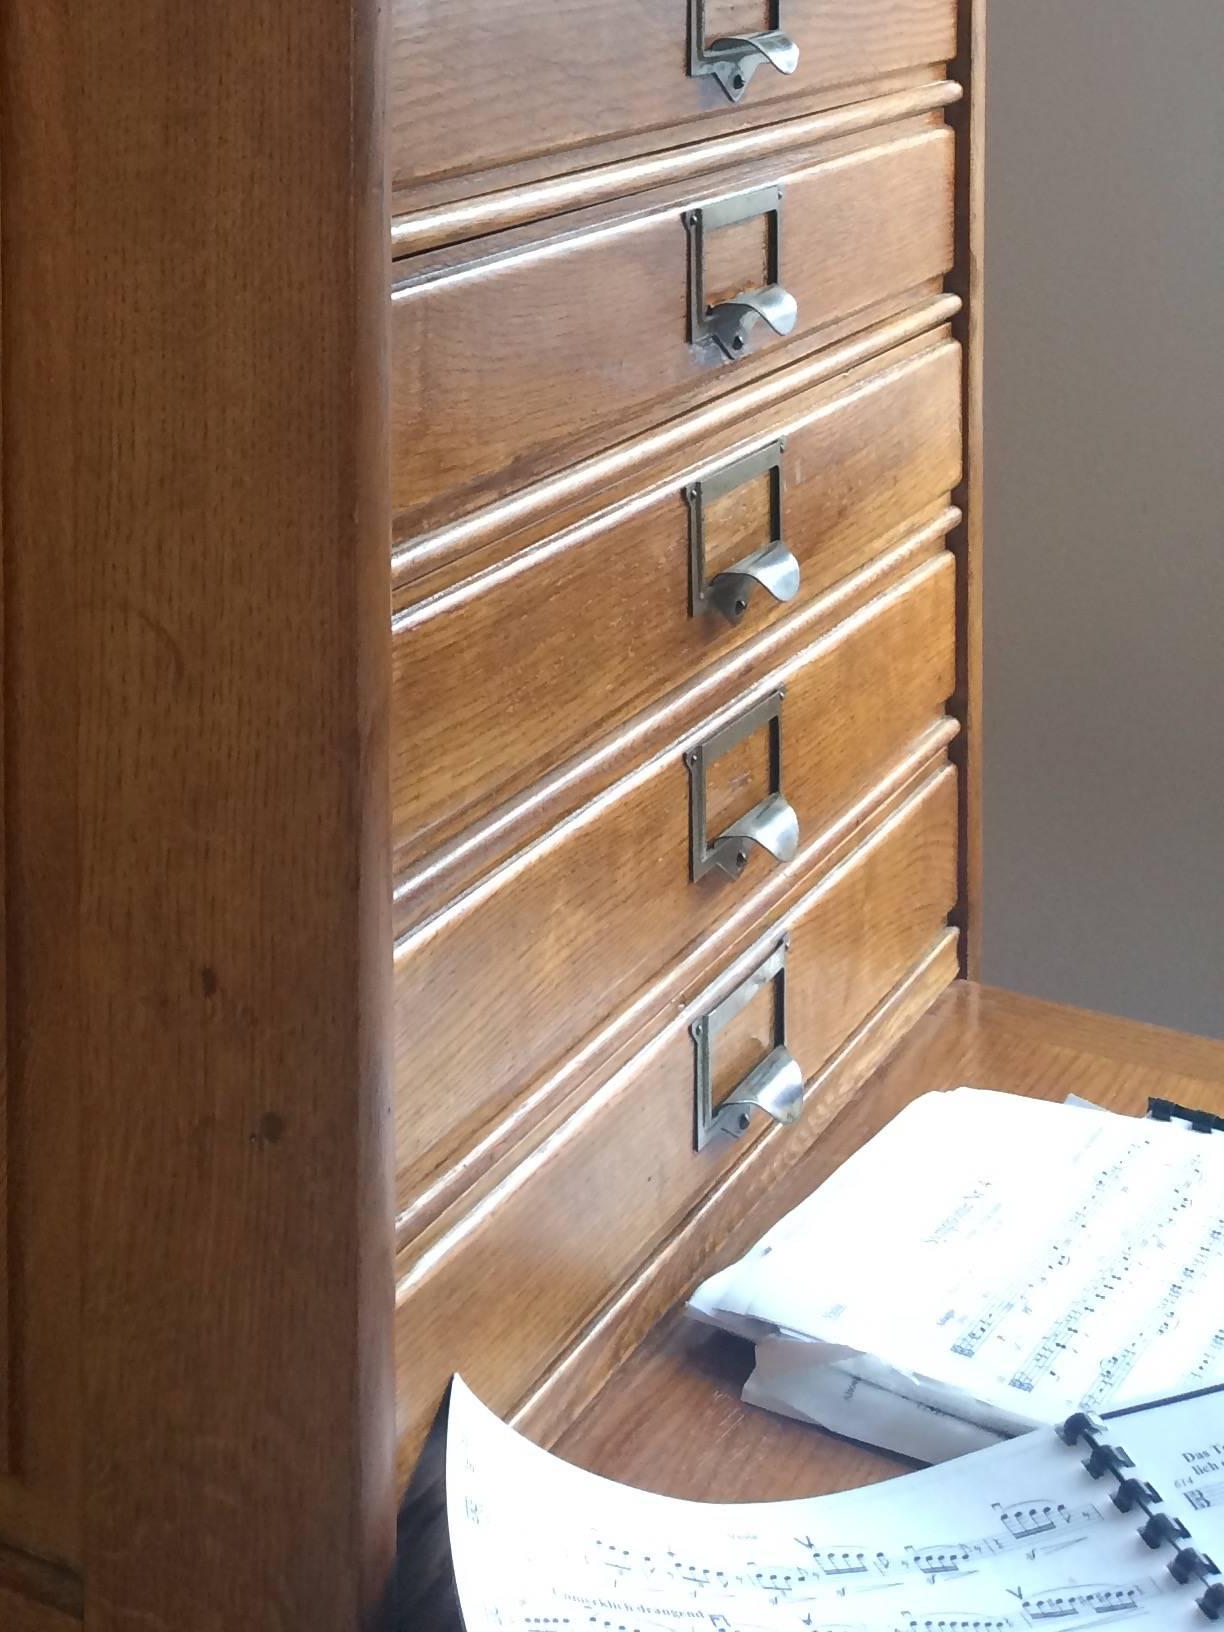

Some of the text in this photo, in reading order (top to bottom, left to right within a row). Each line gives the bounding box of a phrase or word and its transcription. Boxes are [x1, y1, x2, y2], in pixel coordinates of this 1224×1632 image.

[1182, 1444, 1224, 1463] Das T
[1192, 1462, 1219, 1475] lich
